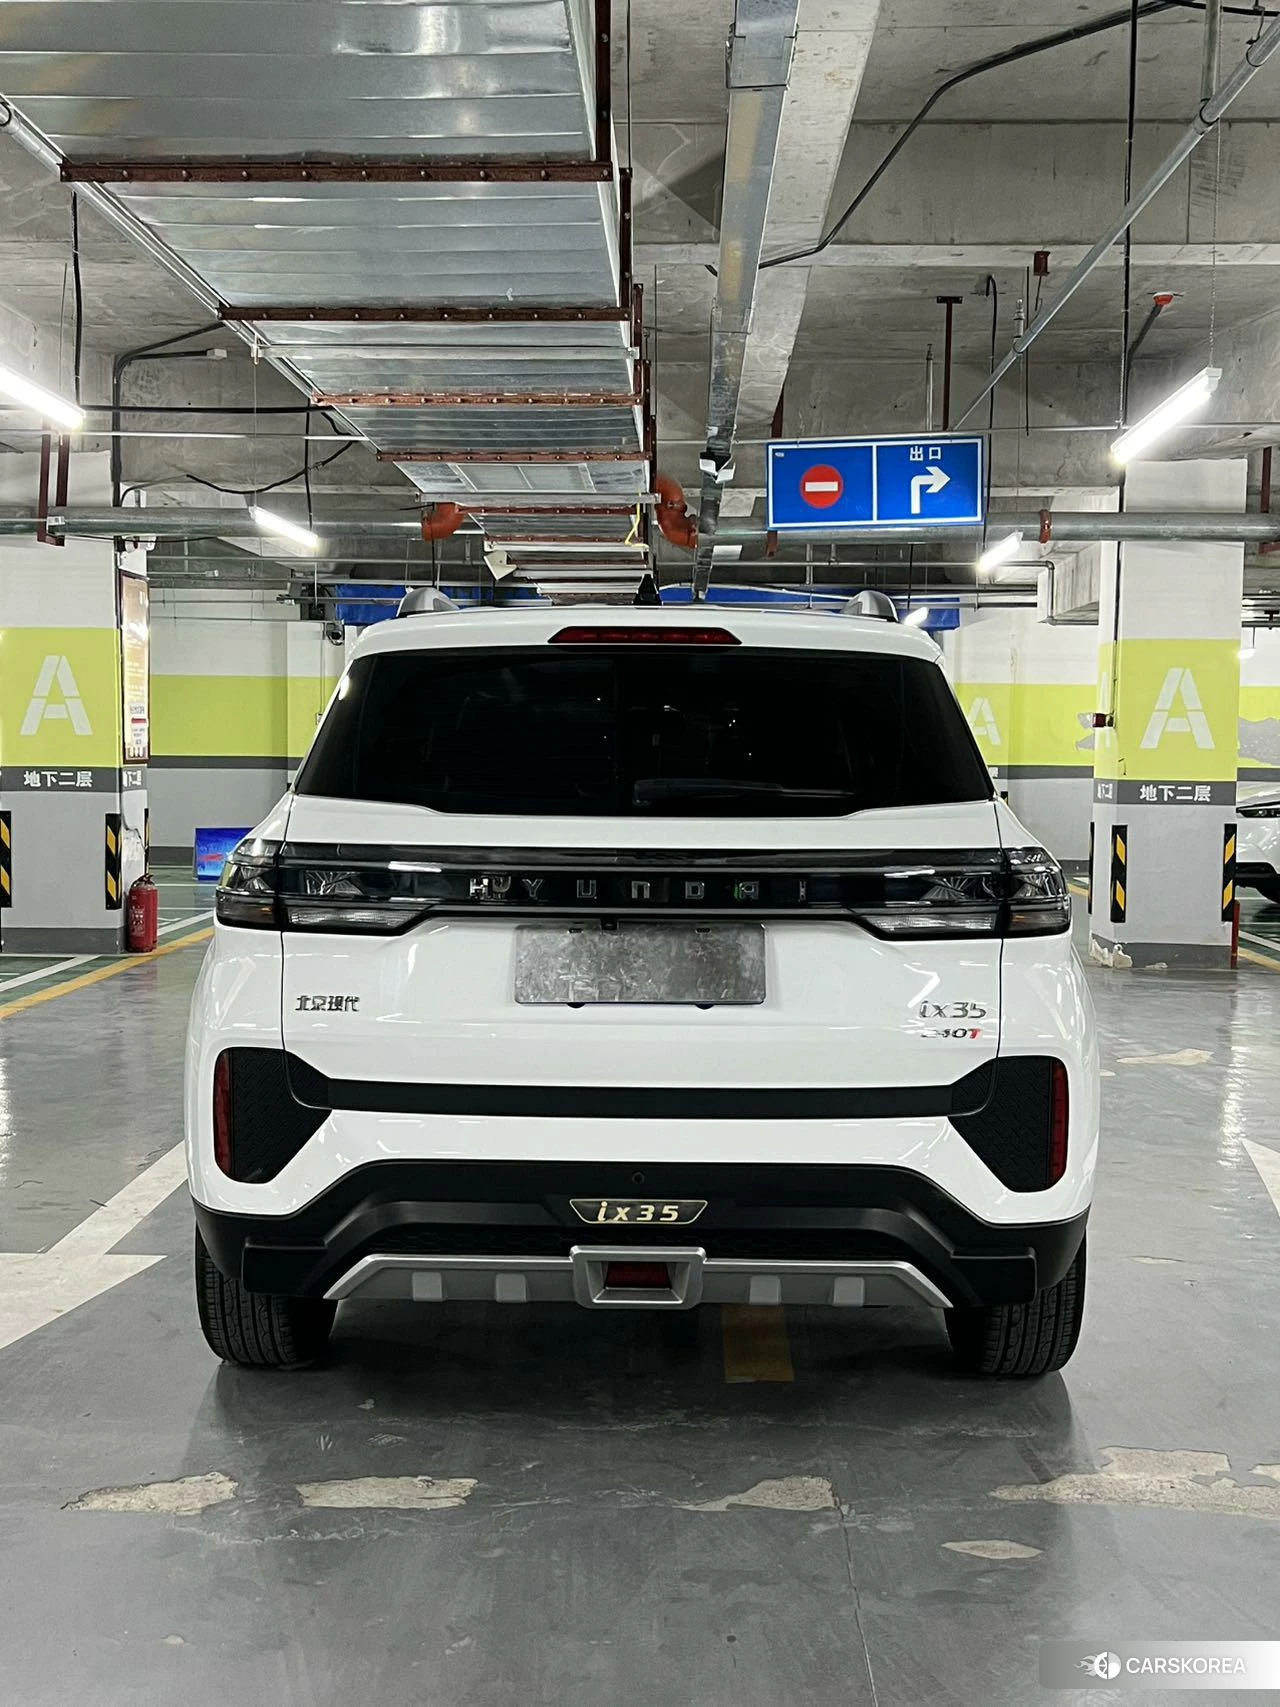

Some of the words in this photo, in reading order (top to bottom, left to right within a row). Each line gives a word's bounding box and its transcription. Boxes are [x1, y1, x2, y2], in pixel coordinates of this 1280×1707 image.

[910, 446, 941, 461] 出口
[20, 655, 93, 736] A
[1139, 667, 1215, 750] A
[24, 770, 93, 788] 地下二层
[1139, 784, 1211, 803] 地下二层
[920, 1000, 987, 1019] ix35
[597, 1201, 679, 1222] ix35
